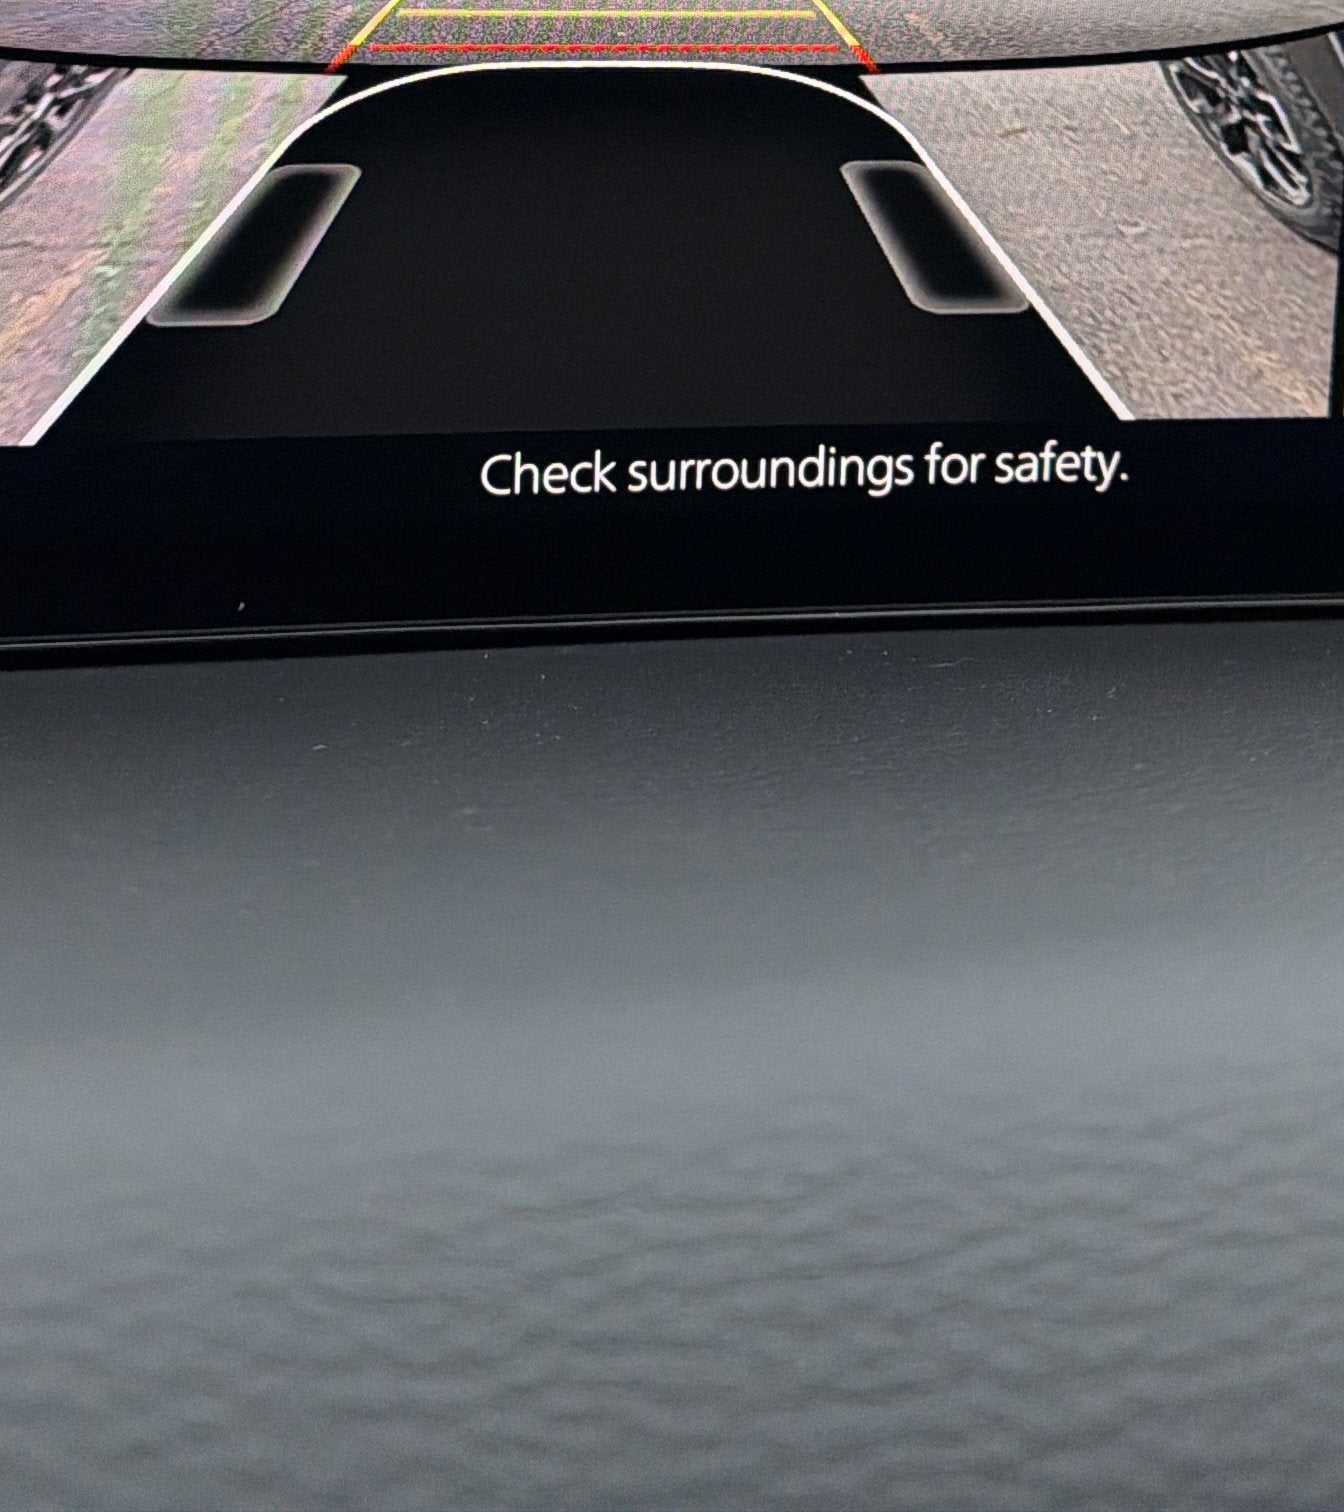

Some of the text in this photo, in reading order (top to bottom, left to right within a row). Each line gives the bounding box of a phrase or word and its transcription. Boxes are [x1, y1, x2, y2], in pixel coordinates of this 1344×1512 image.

[481, 439, 1128, 497] Check surroundings for safety.
